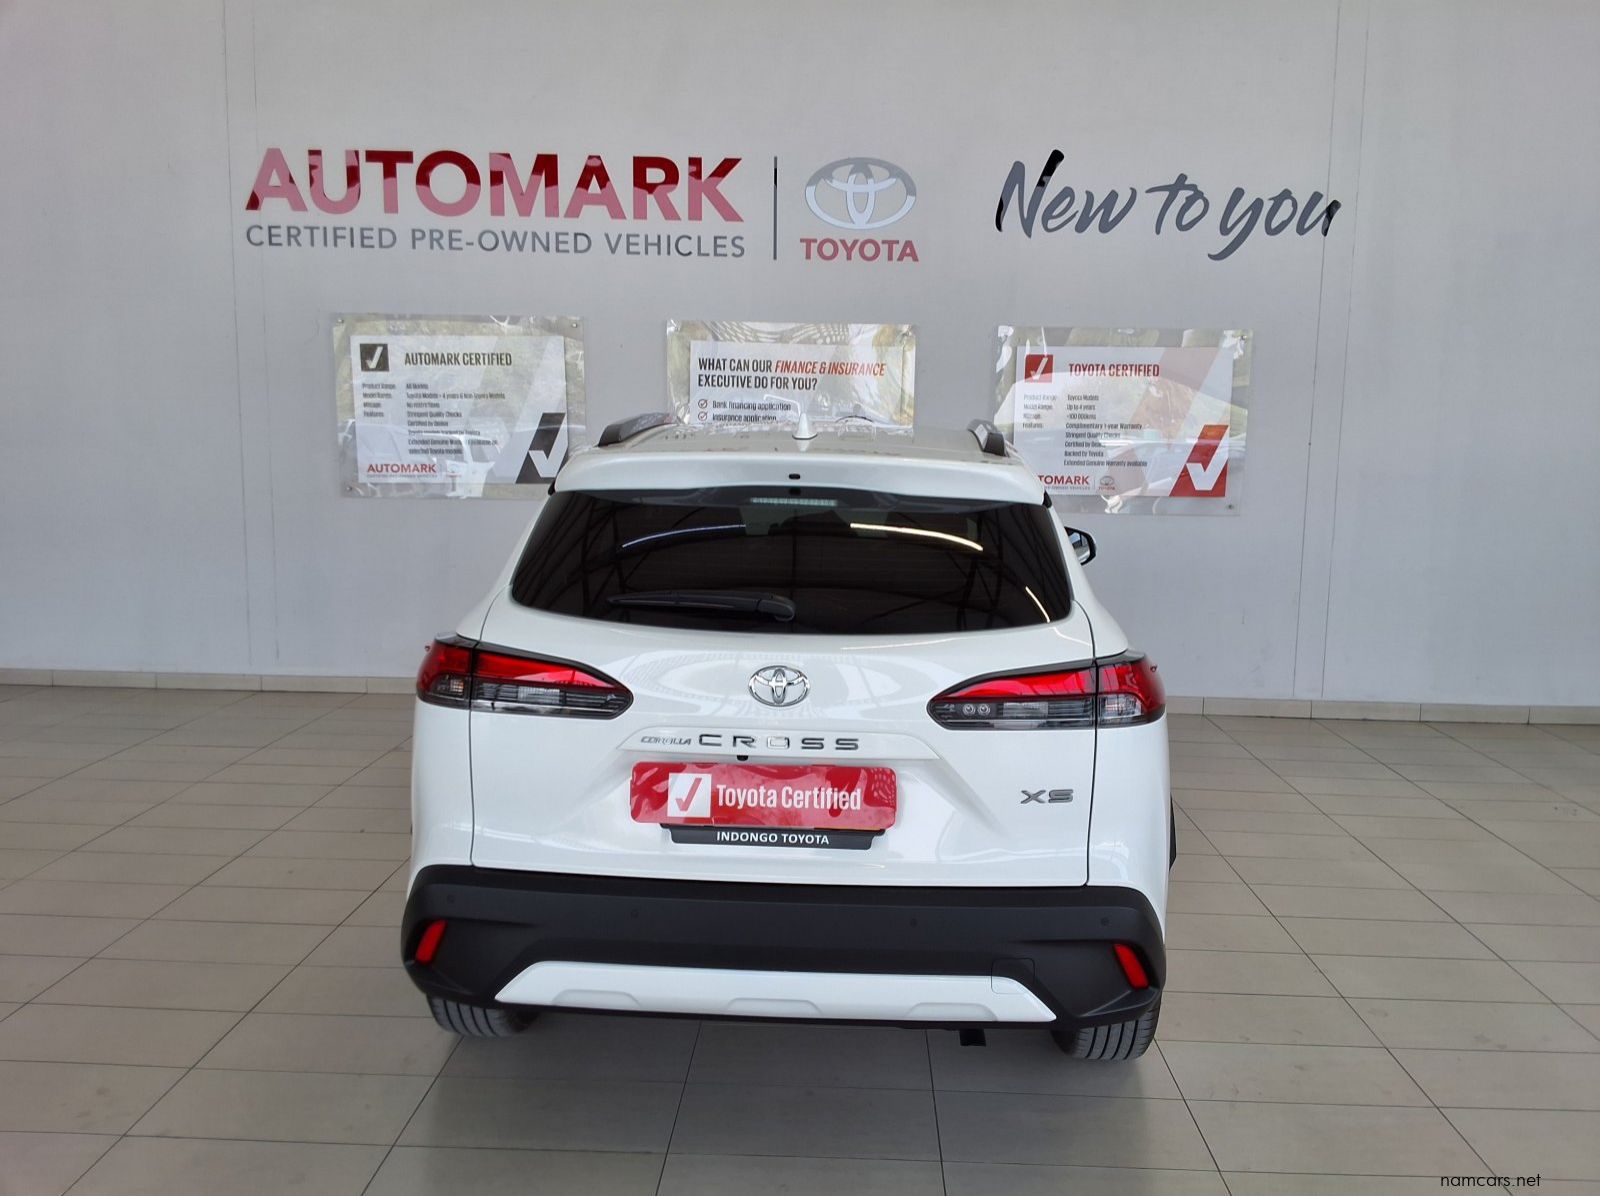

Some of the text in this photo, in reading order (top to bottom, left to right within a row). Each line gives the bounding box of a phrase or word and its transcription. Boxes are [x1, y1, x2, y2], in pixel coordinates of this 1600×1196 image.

[245, 147, 745, 223] AUTOMARK
[995, 149, 1342, 261] New to you
[245, 224, 746, 259] CERTIFIED PRE-OWNED VEHICLES
[799, 238, 920, 263] TOYOTA
[404, 352, 513, 367] AUTOMARK CERTIFIED
[698, 357, 887, 377] WHAT CAN OUR FINANCE & INSURANCE
[1068, 363, 1160, 377] TOYOTA CERTIFIED
[698, 374, 818, 391] EXECUTIVE DO FOR YOU?
[713, 401, 791, 411] Bank financing application
[713, 413, 742, 421] Insurance
[367, 463, 437, 474] AUTOMARK
[1037, 474, 1090, 485] TOMARK
[641, 733, 859, 751] COROLLA CROSS
[716, 784, 862, 811] Toyota Certified
[1020, 788, 1074, 804] XS
[716, 831, 829, 845] INDONGO TOYOTA
